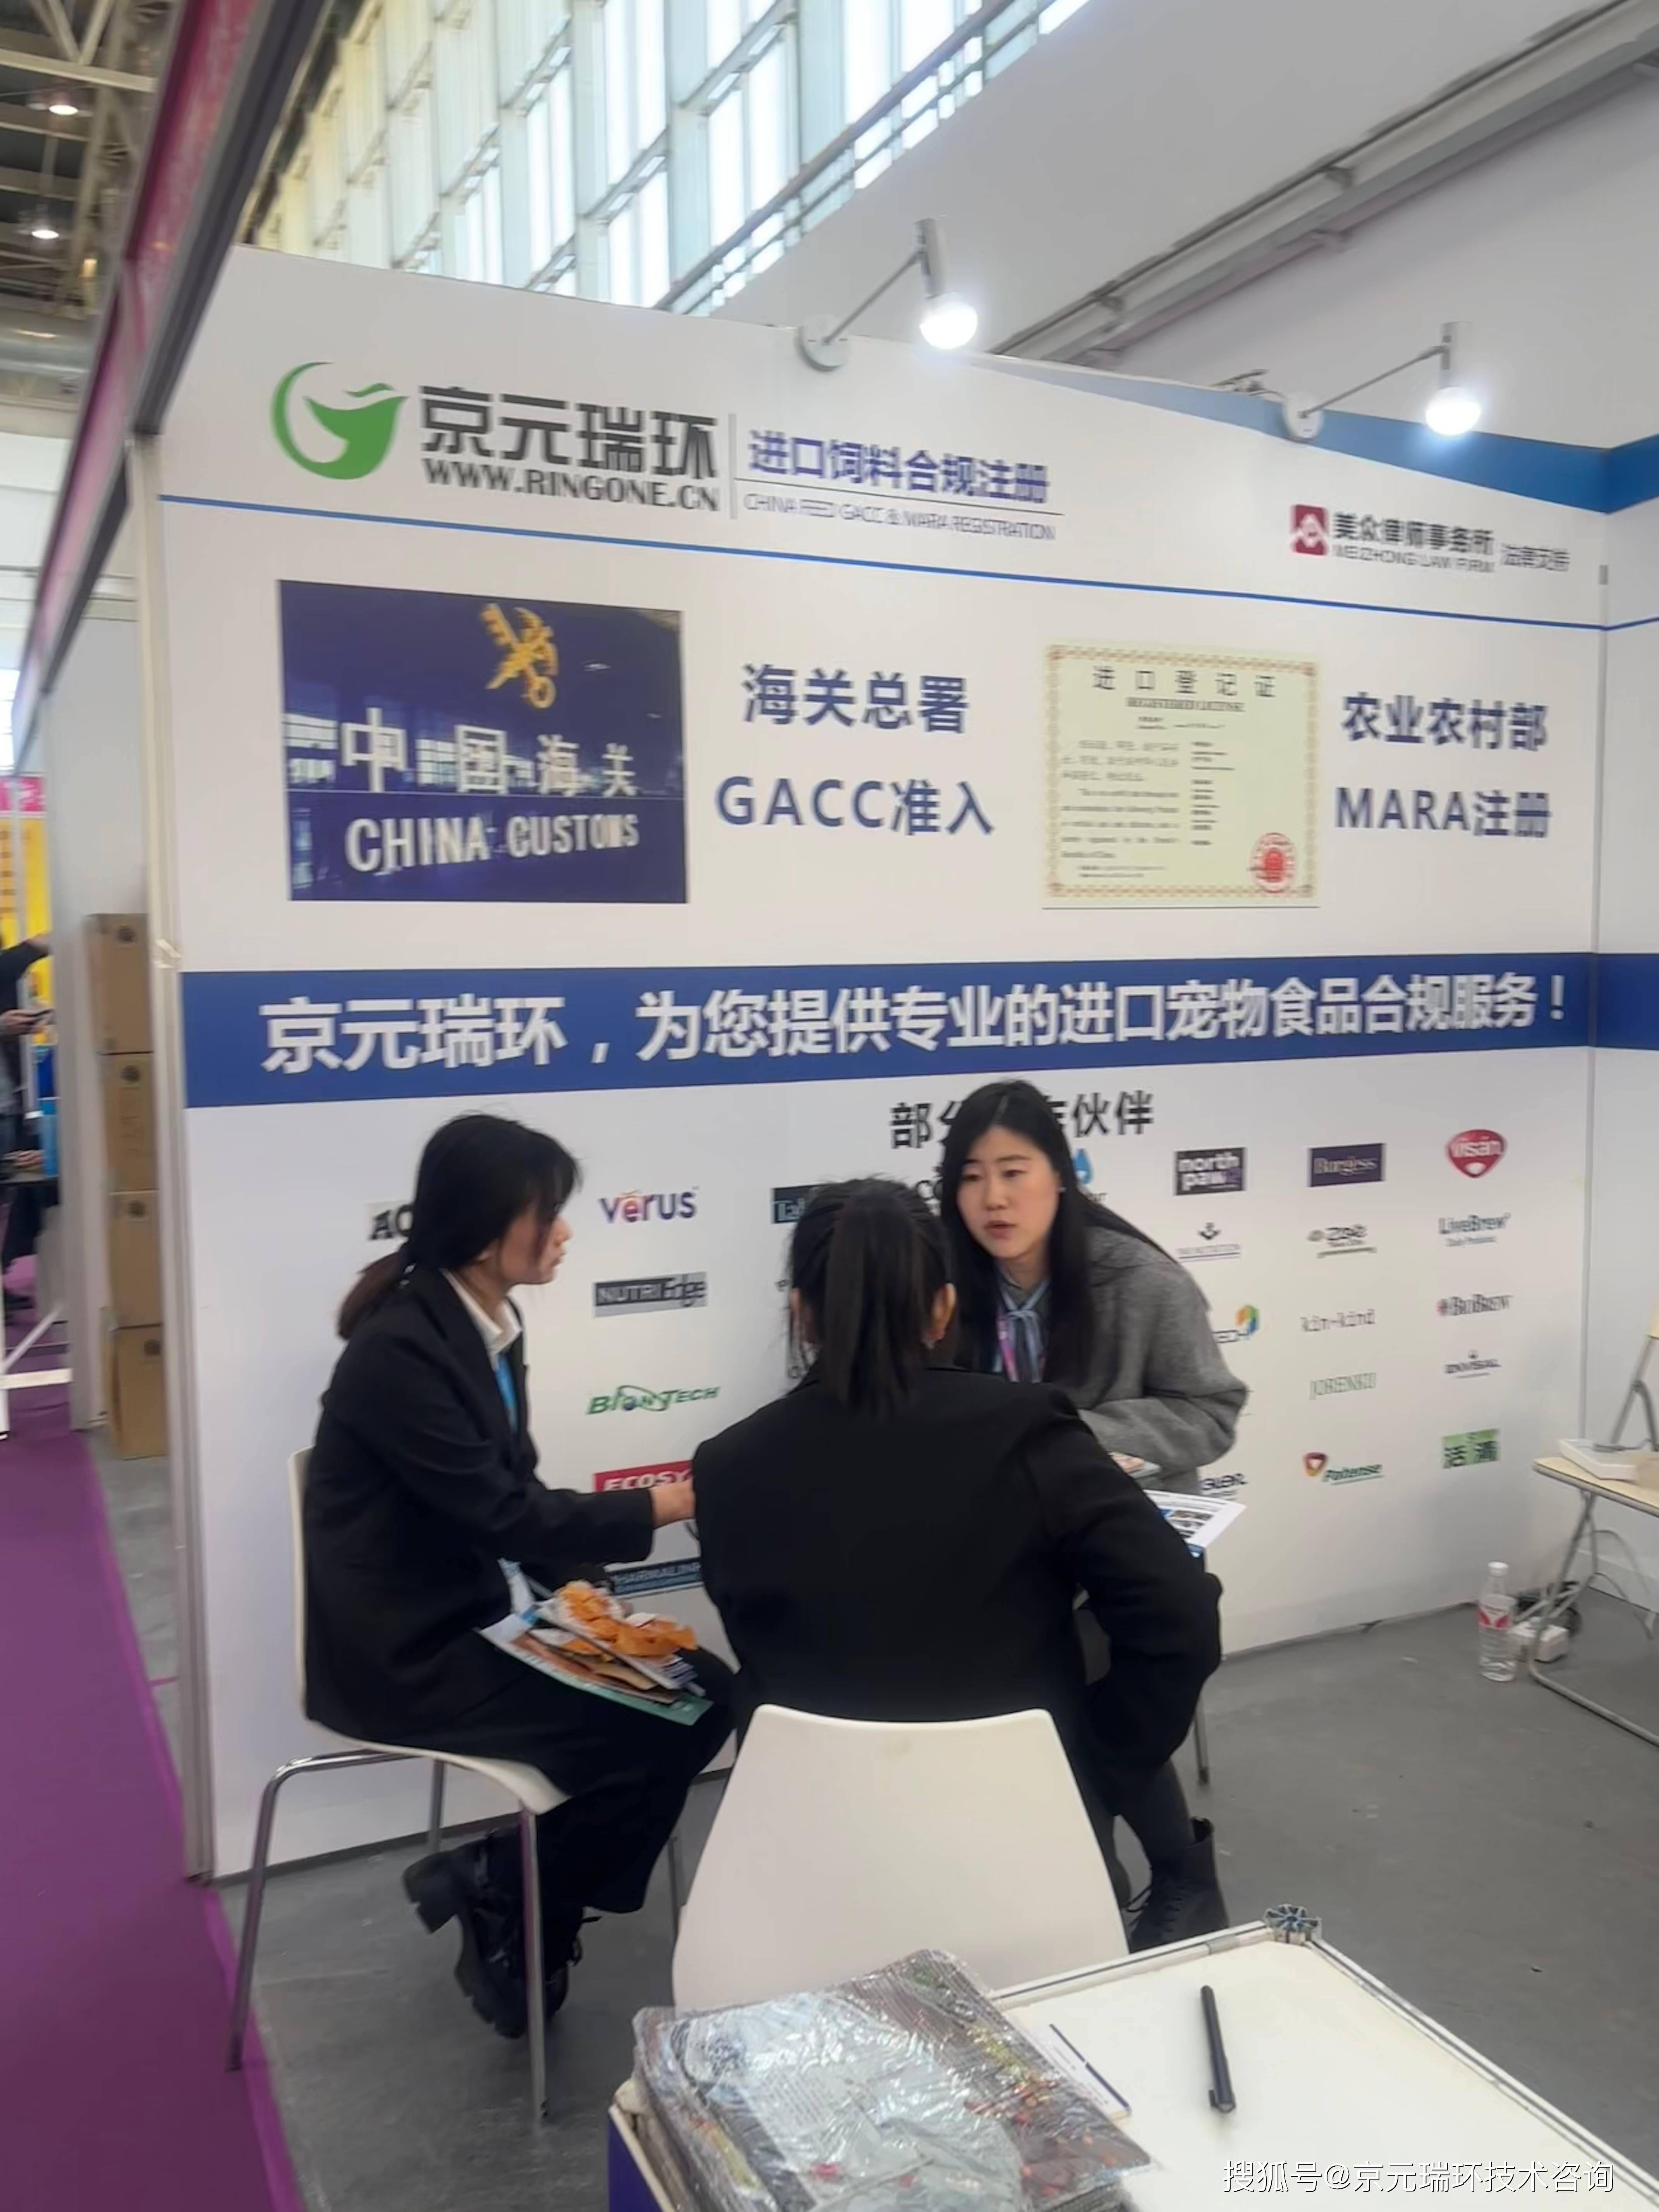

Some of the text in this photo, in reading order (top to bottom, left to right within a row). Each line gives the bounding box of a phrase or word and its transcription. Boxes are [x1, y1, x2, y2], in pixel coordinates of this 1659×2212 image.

[418, 385, 718, 479] 京元瑞环
[421, 458, 720, 512] WWW.RINGONE.CN
[747, 429, 1050, 504] 进口饲料合规注册
[744, 493, 798, 514] CHINA
[741, 663, 970, 734] 海关总署
[1092, 665, 1276, 698] 进口登记证
[341, 707, 639, 797] 中国海关
[1341, 691, 1549, 752] 农业农村部
[715, 775, 995, 836] GACC准入
[1334, 787, 1553, 838] MARA注册
[345, 813, 641, 872] CHINA CUSTOMS
